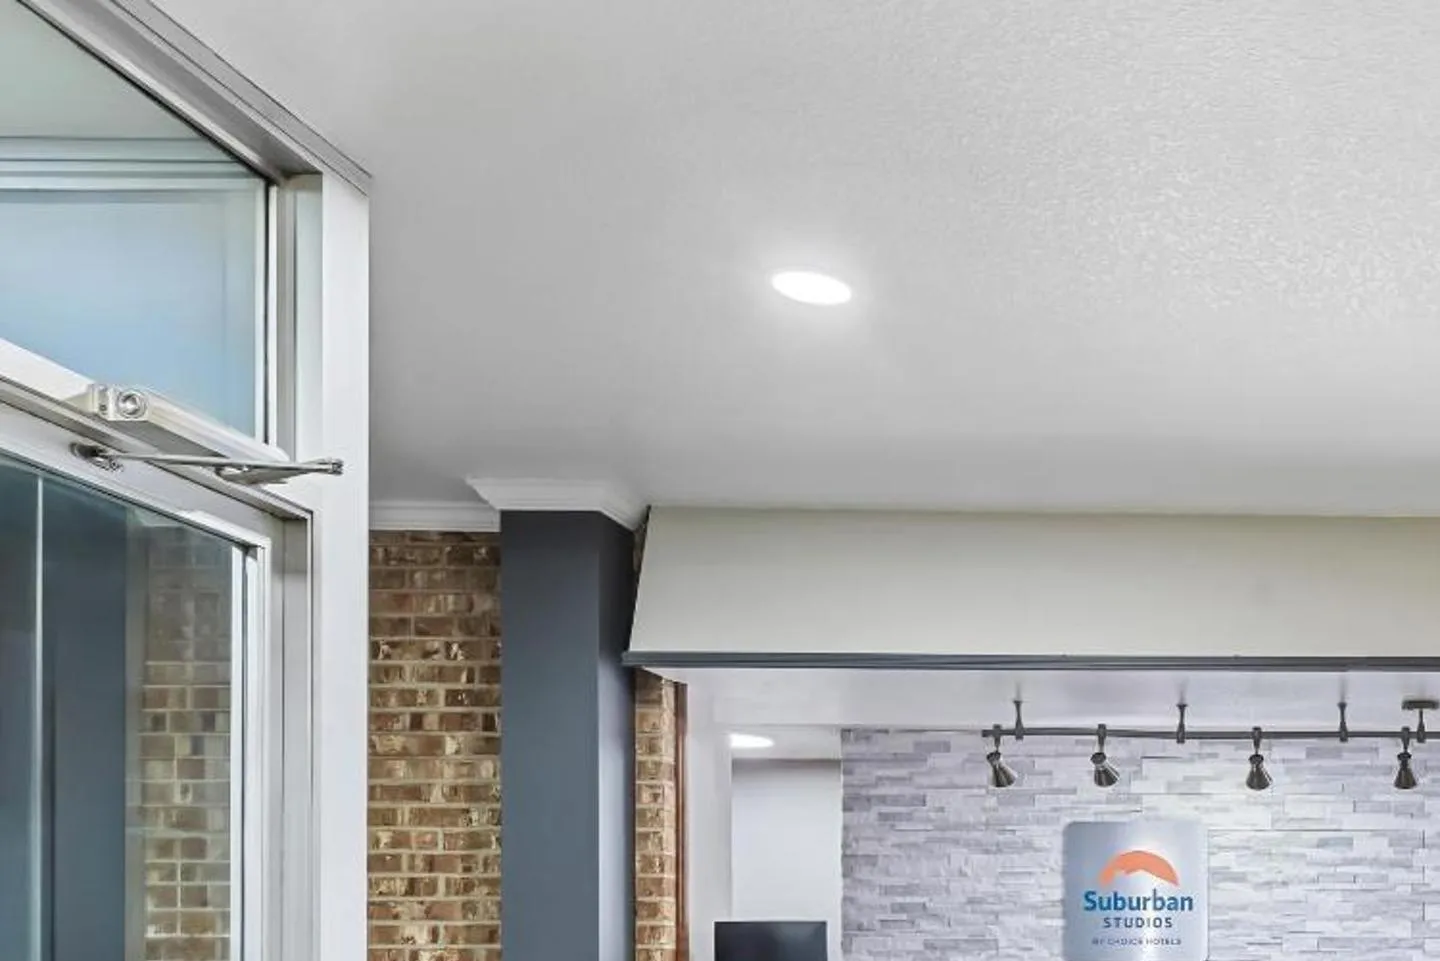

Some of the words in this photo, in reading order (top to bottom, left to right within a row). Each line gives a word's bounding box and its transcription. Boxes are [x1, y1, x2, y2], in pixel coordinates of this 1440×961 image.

[1083, 888, 1194, 912] Suburban
[1103, 917, 1173, 929] STUDIOS
[1145, 936, 1182, 946] HOTELS
